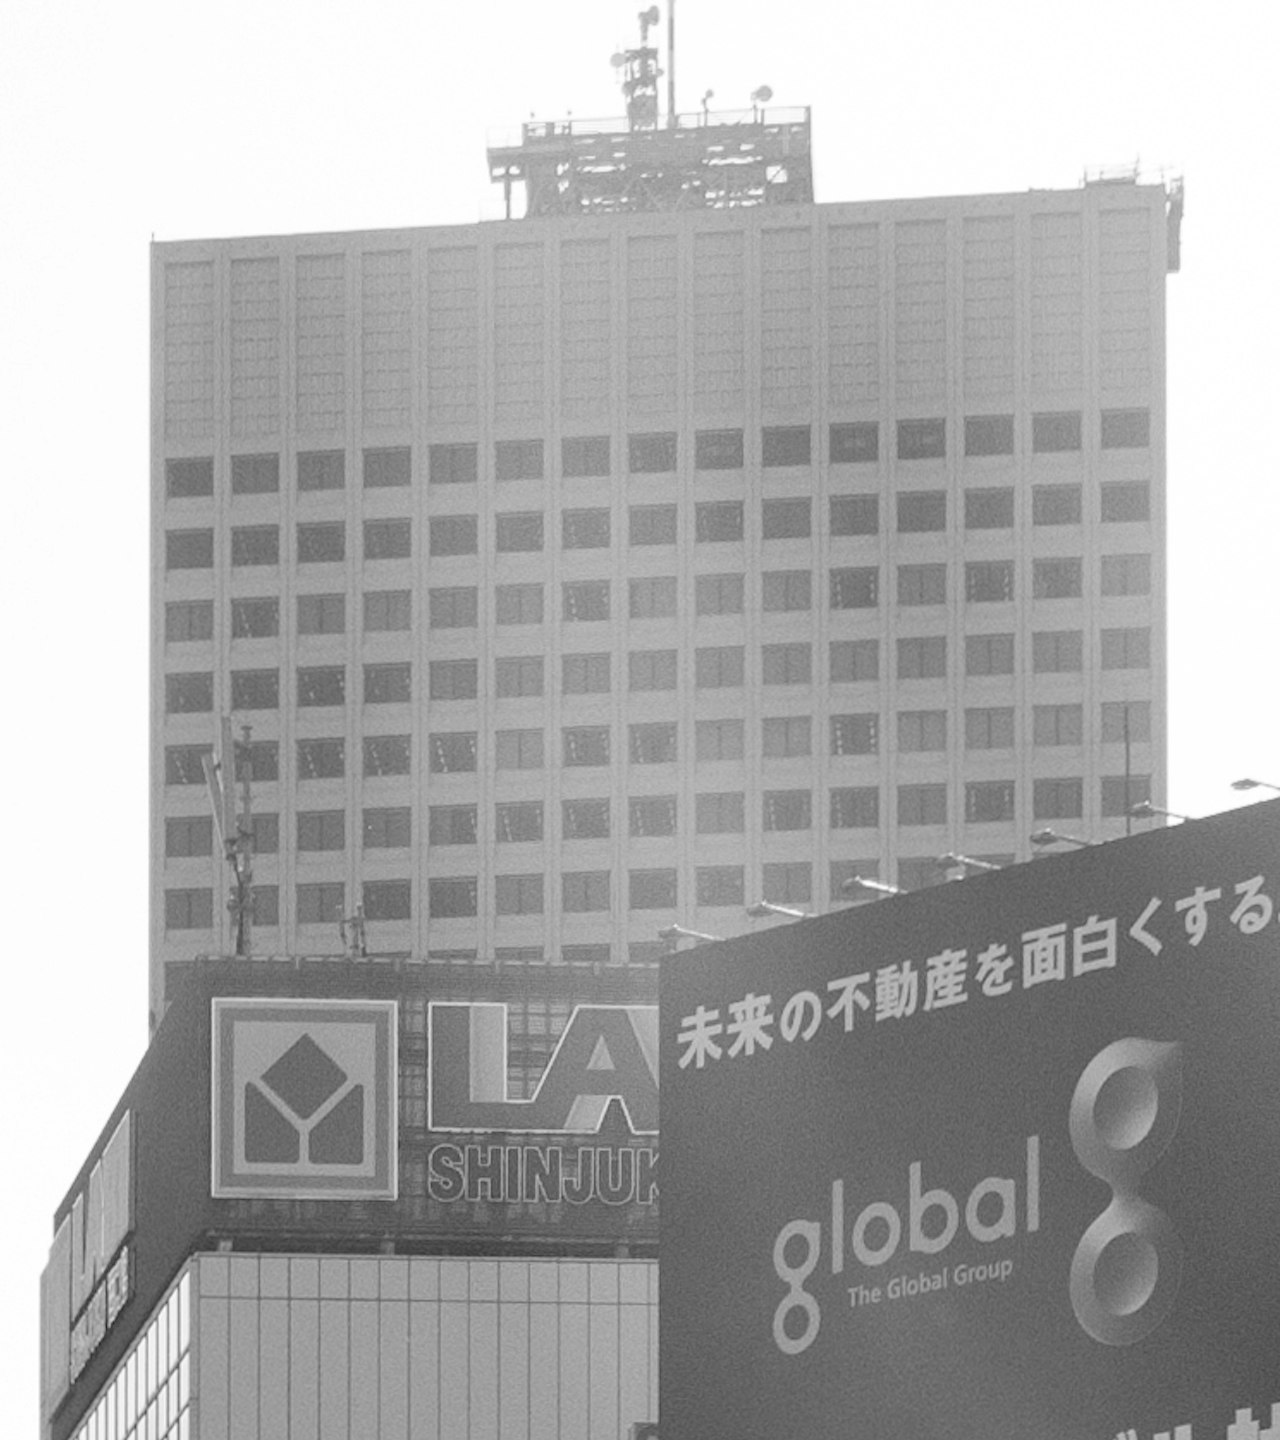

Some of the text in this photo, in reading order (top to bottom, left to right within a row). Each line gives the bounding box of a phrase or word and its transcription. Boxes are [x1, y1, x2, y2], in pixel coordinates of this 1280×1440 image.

[772, 1135, 1040, 1355] global
[847, 1257, 1014, 1309] The Global Group
